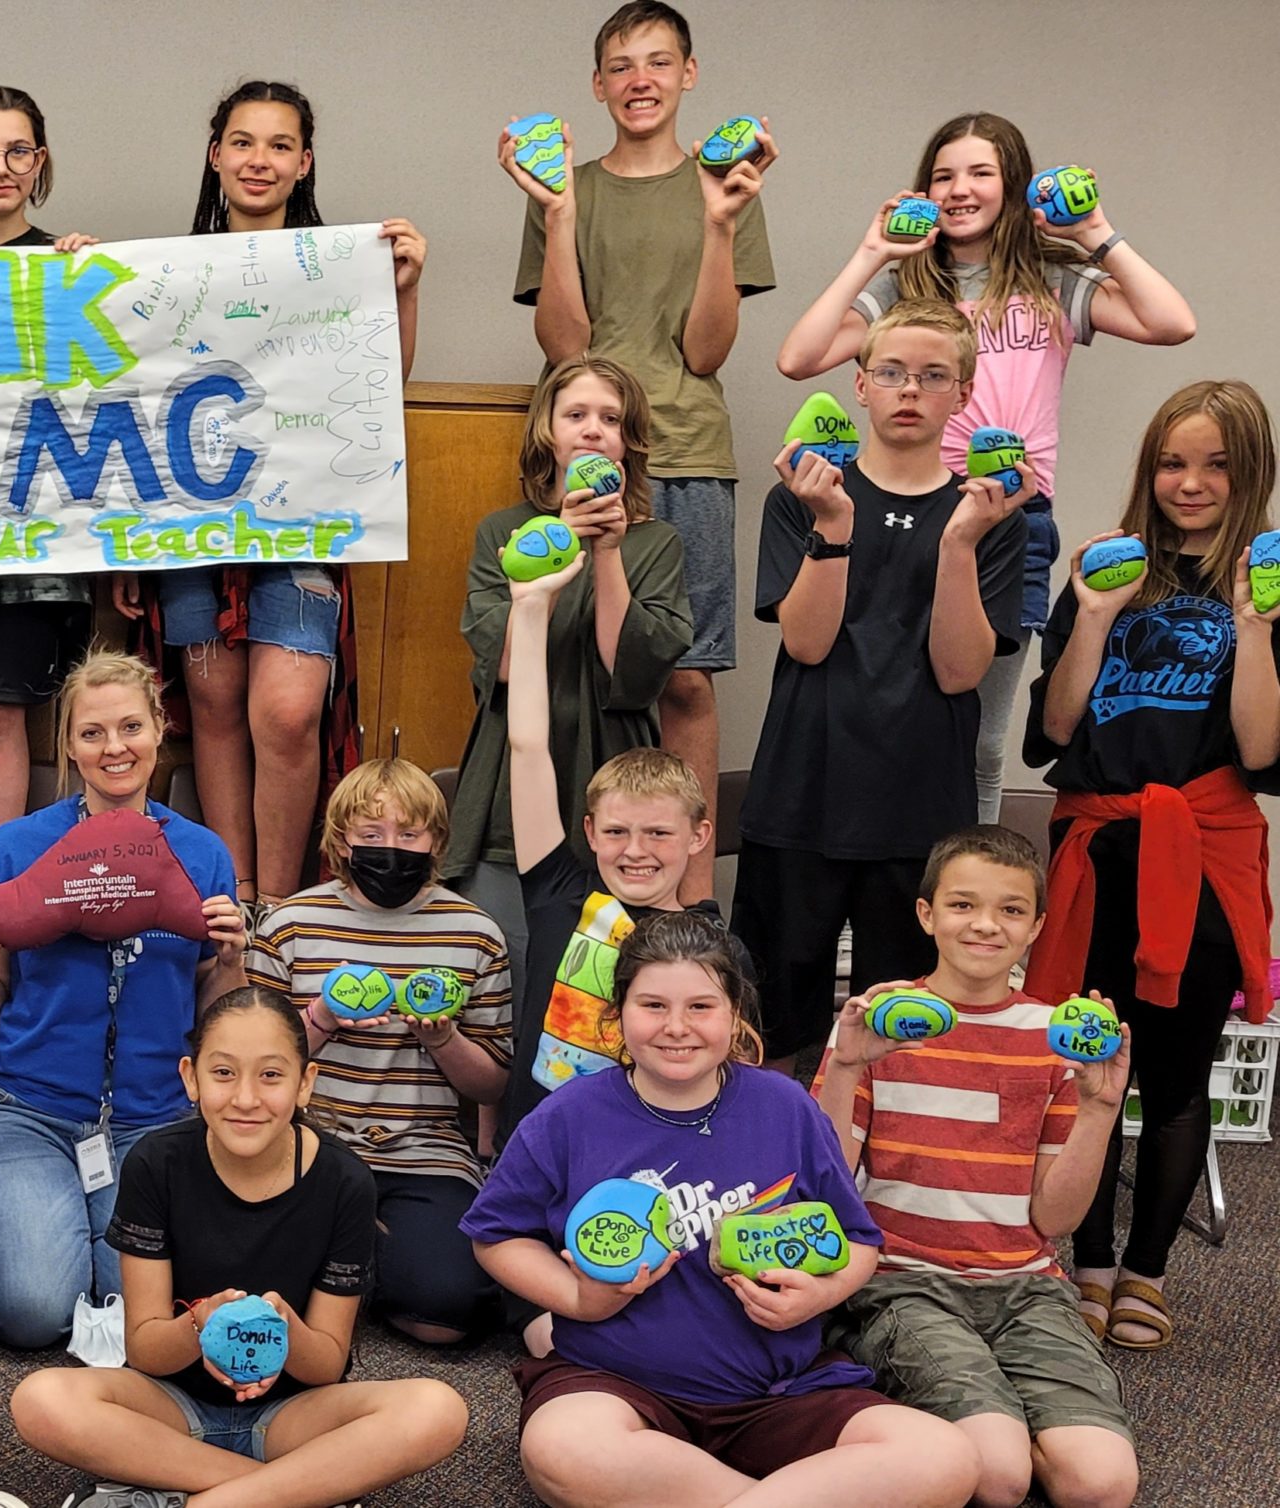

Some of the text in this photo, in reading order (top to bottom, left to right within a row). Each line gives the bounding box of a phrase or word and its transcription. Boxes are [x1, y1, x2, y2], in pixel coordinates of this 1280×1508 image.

[894, 218, 931, 233] LIFE
[984, 434, 1024, 447] DON
[997, 452, 1025, 467] LIF
[92, 501, 364, 567] Teacher
[1093, 656, 1216, 697] Panther
[57, 843, 159, 865] JANUARY 5, 2021
[63, 874, 136, 888] Intermountain
[64, 884, 136, 896] Transplant Services
[44, 889, 156, 905] Intermountain Medical Center
[668, 1180, 715, 1219] Dr
[737, 1214, 808, 1244] Donate
[738, 1243, 775, 1263] Life
[227, 1326, 282, 1346] Donate
[231, 1356, 259, 1373] Life
